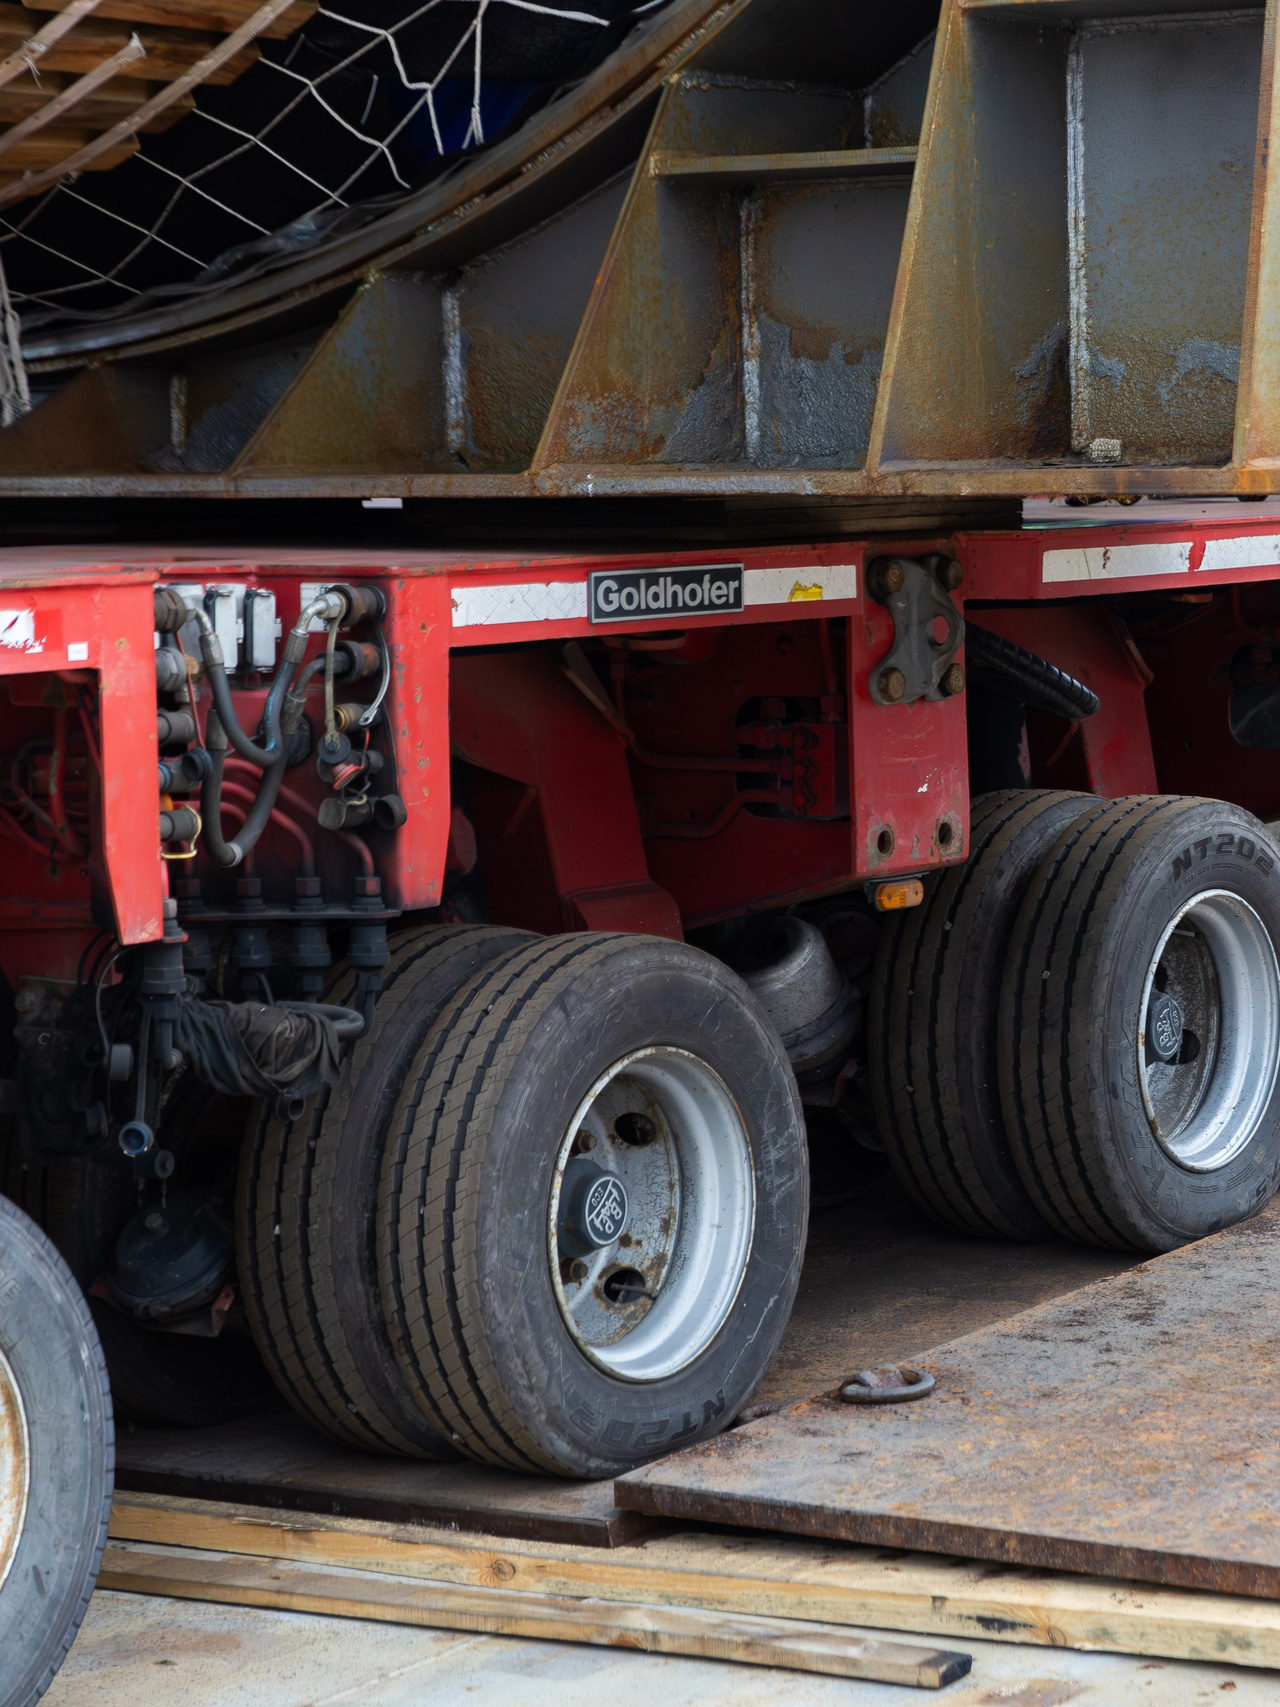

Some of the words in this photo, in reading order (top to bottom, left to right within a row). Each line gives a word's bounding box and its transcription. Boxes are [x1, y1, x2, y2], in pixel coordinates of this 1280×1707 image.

[596, 573, 740, 613] Goldhofer
[1171, 833, 1275, 883] NT202
[591, 1187, 604, 1207] ECO
[570, 1387, 726, 1449] NT202
